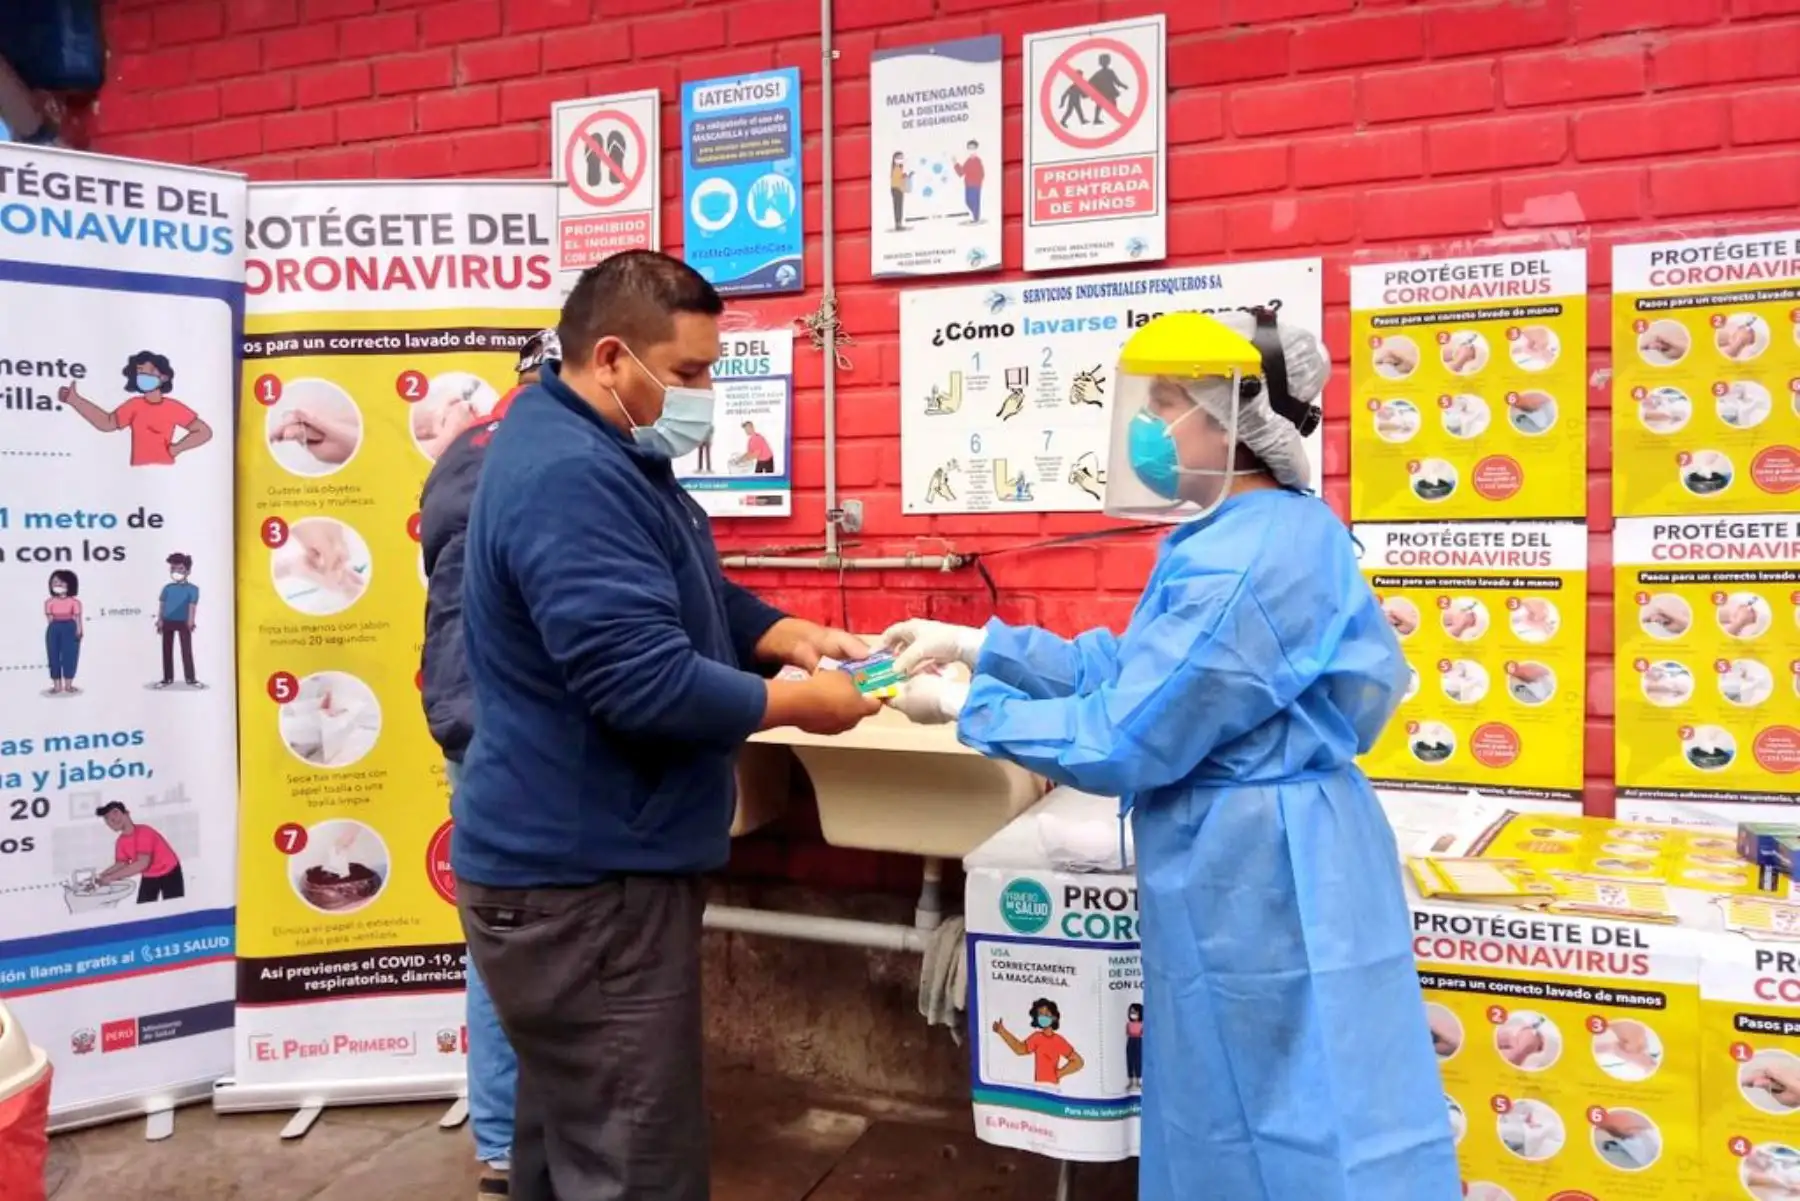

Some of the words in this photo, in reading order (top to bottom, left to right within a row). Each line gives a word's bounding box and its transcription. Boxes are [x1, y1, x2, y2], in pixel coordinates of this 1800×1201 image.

[699, 82, 781, 108] ¡ATENTOS!
[886, 82, 985, 106] MANTENGAMOS
[902, 108, 914, 118] LA
[916, 101, 969, 116] DISTANCIA
[902, 119, 914, 129] DE
[916, 113, 969, 128] SEGURIDAD
[1043, 164, 1143, 183] PROHIBIDA
[1037, 188, 1057, 200] LA
[1065, 179, 1150, 196] ENTRADA
[157, 185, 229, 219] DEL
[1050, 202, 1073, 214] DE
[1078, 195, 1136, 211] NIÑOS
[467, 213, 549, 246] DEL
[565, 220, 646, 237] PROHIBIDO
[565, 240, 581, 250] EL
[584, 234, 646, 249] INGRESO
[565, 253, 587, 264] CON
[1650, 240, 1787, 266] PROTÉGETE
[1385, 262, 1504, 286] PROTÉGETE
[1511, 259, 1552, 276] DEL
[1023, 287, 1072, 303] SERVICIOS
[1075, 280, 1147, 299] INDUSTRIALES
[1149, 275, 1207, 295] PESQUEROS
[1208, 275, 1222, 289] SA
[1383, 277, 1552, 306] CORONAVIRUS
[1639, 300, 1668, 309] Pasos
[1670, 298, 1693, 308] para
[1711, 294, 1755, 303] correcto
[1757, 290, 1794, 300] lavado
[932, 317, 1015, 346] ¿Cómo
[1023, 311, 1117, 337] lavarse
[266, 337, 299, 353] para
[303, 337, 325, 349] un
[329, 334, 401, 348] correcto
[405, 332, 461, 347] lavado
[464, 331, 486, 346] de
[491, 334, 528, 346] man
[735, 340, 770, 356] DEL
[972, 351, 981, 372] 1
[1041, 346, 1053, 368] 2
[264, 380, 275, 401] 1
[406, 377, 420, 396] 2
[970, 433, 981, 454] 6
[1042, 430, 1053, 451] 7
[0, 507, 8, 529] 1
[25, 509, 118, 529] metro
[127, 506, 164, 529] de
[268, 522, 282, 542] 3
[1387, 528, 1505, 547] PROTÉGETE
[1511, 532, 1552, 547] DEL
[1653, 519, 1788, 540] PROTÉGETE
[16, 546, 72, 563] con
[83, 539, 126, 562] los
[1385, 550, 1551, 567] CORONAVIRUS
[1671, 573, 1694, 582] para
[1712, 572, 1756, 580] correcto
[1758, 571, 1795, 580] lavado
[108, 607, 141, 617] metro
[307, 635, 323, 646] 20
[274, 678, 290, 698] 5
[1, 739, 34, 757] as
[43, 726, 145, 753] manos
[32, 770, 50, 793] y
[57, 757, 154, 791] jabón,
[10, 796, 51, 822] 20
[0, 835, 36, 854] os
[283, 830, 299, 850] 7
[1014, 901, 1048, 916] SALUD
[1060, 912, 1140, 940] COR
[1413, 911, 1582, 944] PROTÉGETE
[1592, 925, 1650, 949] DEL
[30, 961, 73, 979] llama
[76, 953, 118, 973] gratis
[121, 951, 135, 965] al
[155, 943, 180, 960] 113
[183, 936, 230, 952] SALUD
[990, 947, 1011, 957] USA
[1108, 956, 1143, 966] MANT
[1412, 935, 1650, 977] CORONAVIRUS
[260, 966, 283, 980] Así
[286, 961, 359, 981] previenes
[361, 956, 375, 969] el
[378, 955, 425, 969] COVID
[428, 954, 456, 968] -19,
[990, 960, 1077, 976] CORRECTAMENTE
[1108, 969, 1122, 978] DE
[304, 974, 398, 992] respiratorias,
[991, 971, 1004, 981] LA
[1005, 972, 1070, 988] MASCARILLA.
[1108, 980, 1132, 990] CON
[1437, 977, 1467, 992] para
[1468, 978, 1486, 990] un
[1488, 980, 1543, 996] correcto
[1546, 984, 1592, 1001] lavado
[1595, 988, 1613, 1002] de
[1615, 992, 1663, 1007] manos
[1492, 1009, 1501, 1022] 2
[1593, 1019, 1602, 1031] 3
[1738, 1015, 1781, 1031] Pasos
[333, 1034, 410, 1055] PRIMERO
[1735, 1046, 1746, 1058] 1
[1065, 1106, 1082, 1116] Para
[1495, 1098, 1507, 1111] 5
[1590, 1109, 1602, 1122] 6
[1734, 1140, 1746, 1153] 4
